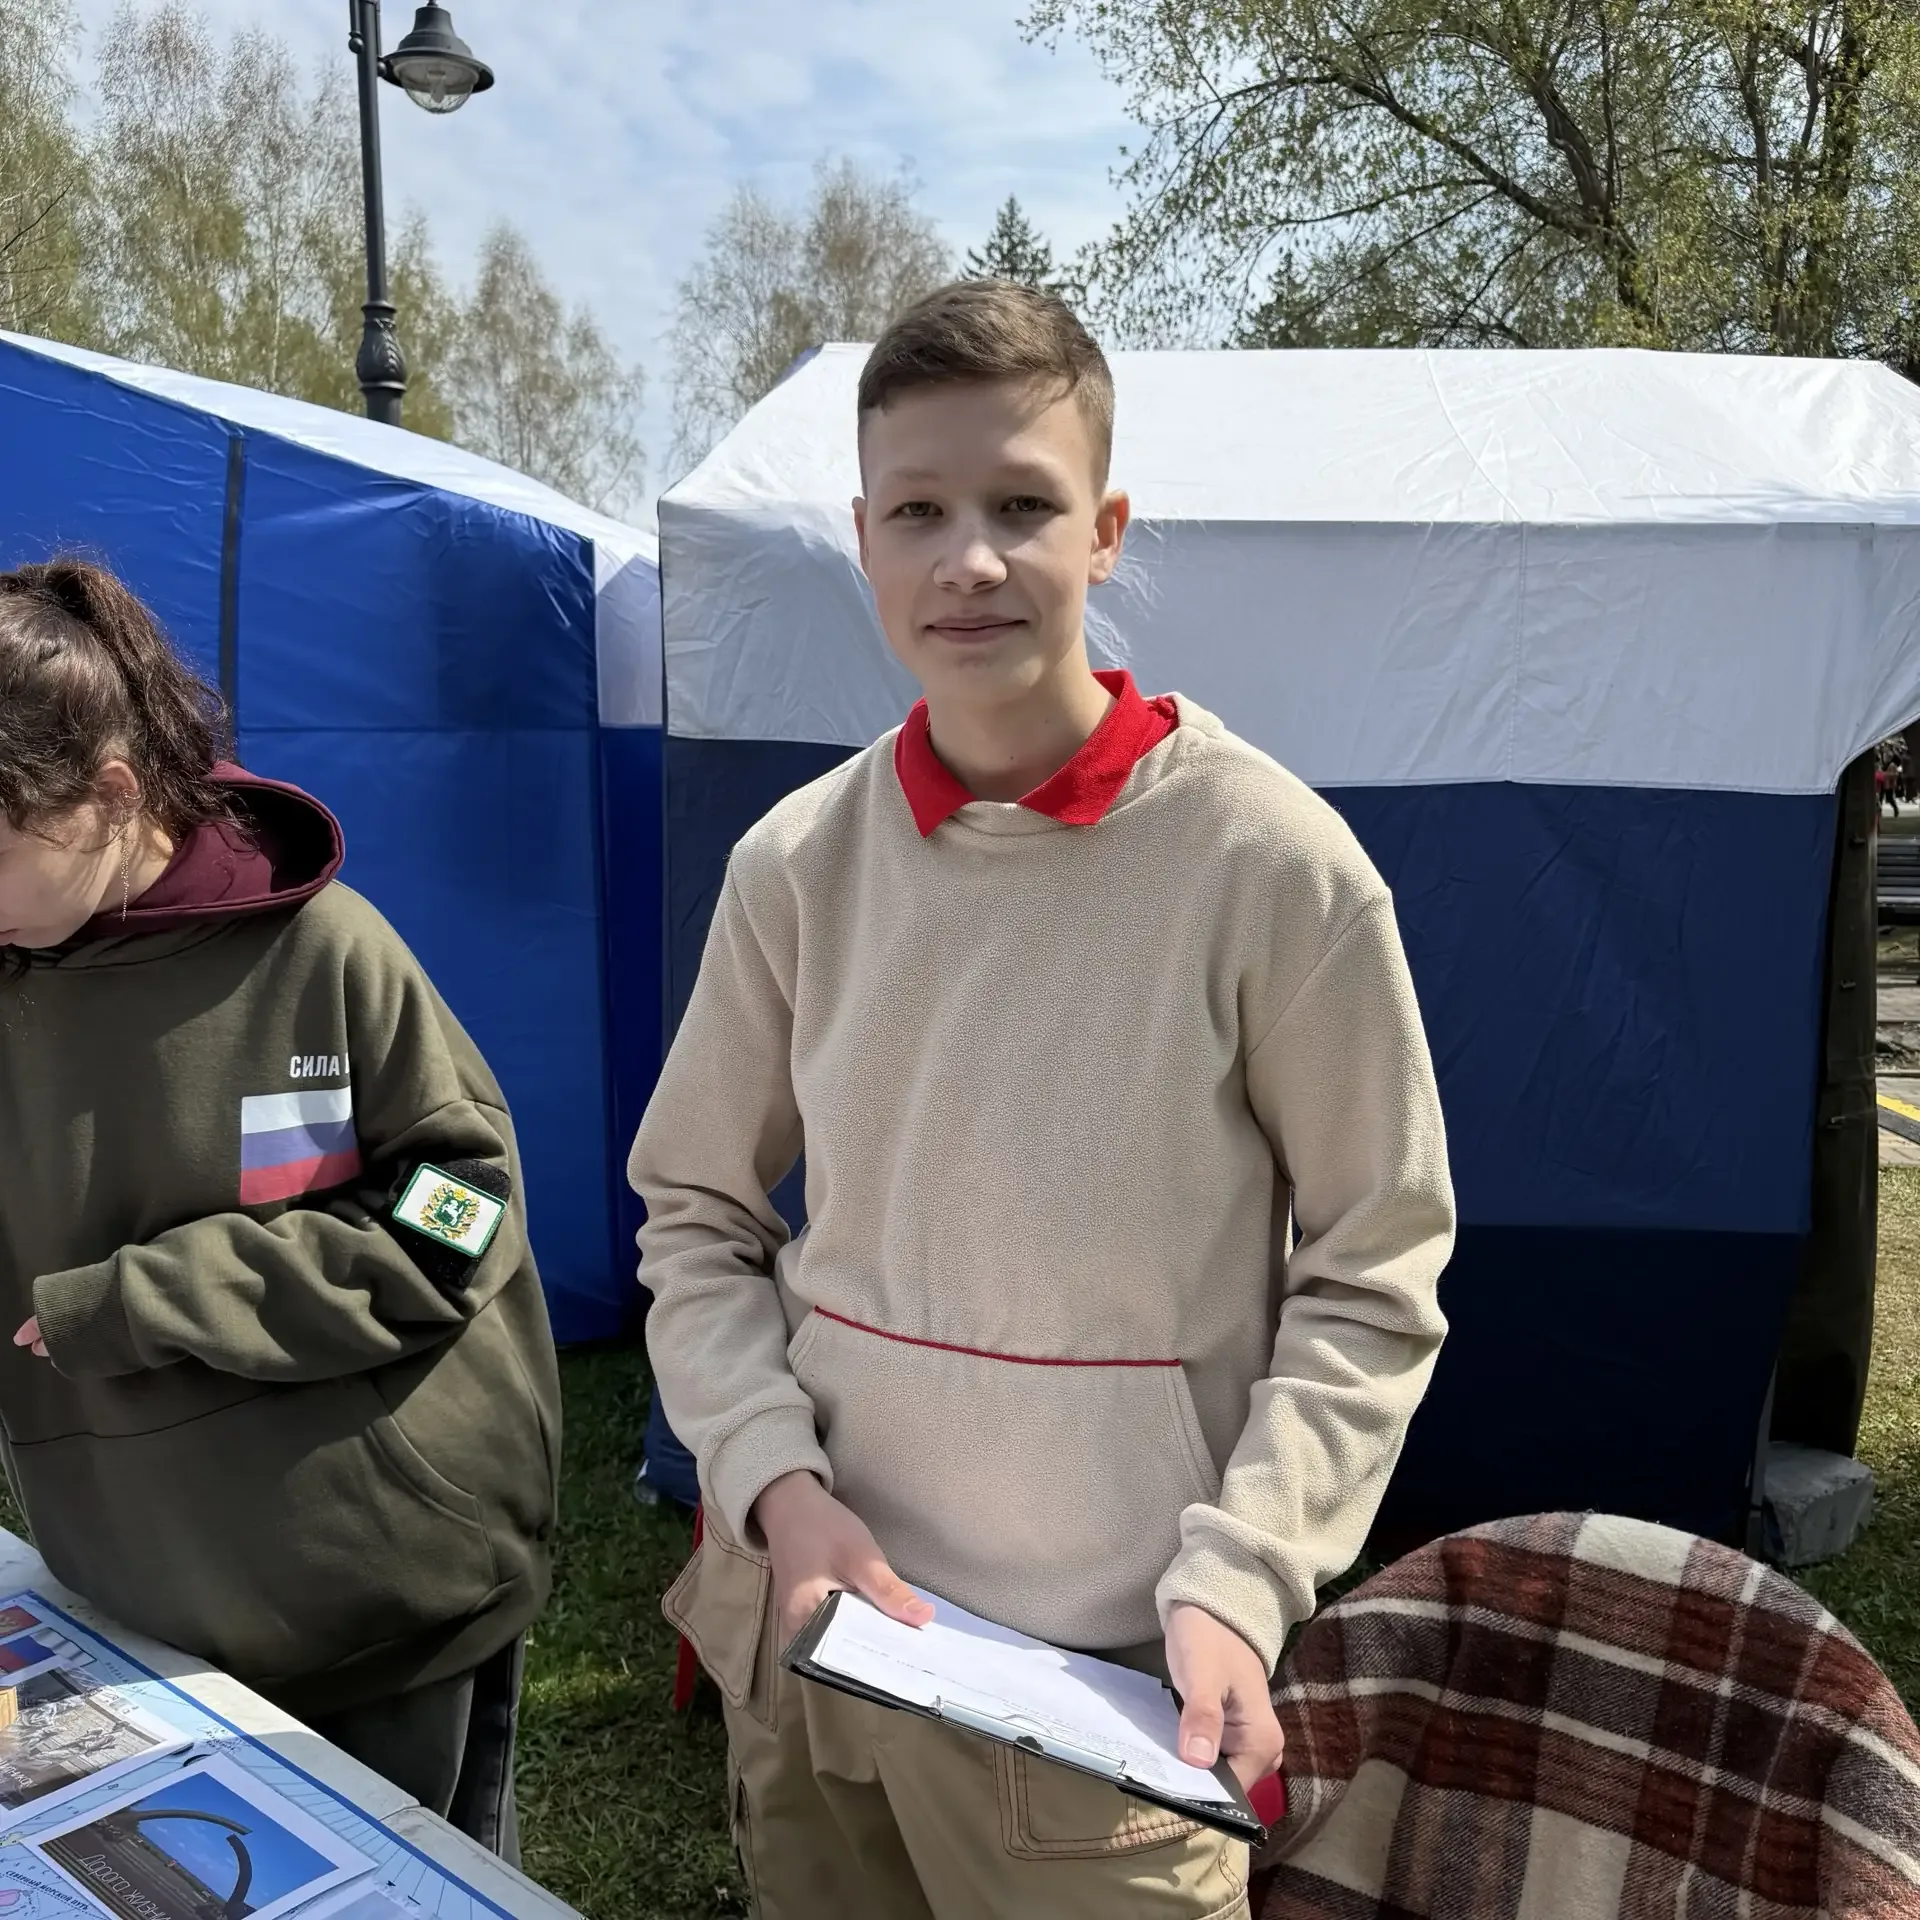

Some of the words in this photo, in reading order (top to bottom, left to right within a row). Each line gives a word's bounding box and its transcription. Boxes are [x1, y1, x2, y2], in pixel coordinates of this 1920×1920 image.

[290, 1055, 341, 1078] СИЛА
[5, 1870, 42, 1887] СЕВЕРНЫЙ
[39, 1883, 72, 1903] МОРСКОЙ
[70, 1896, 89, 1911] ПУТЬ
